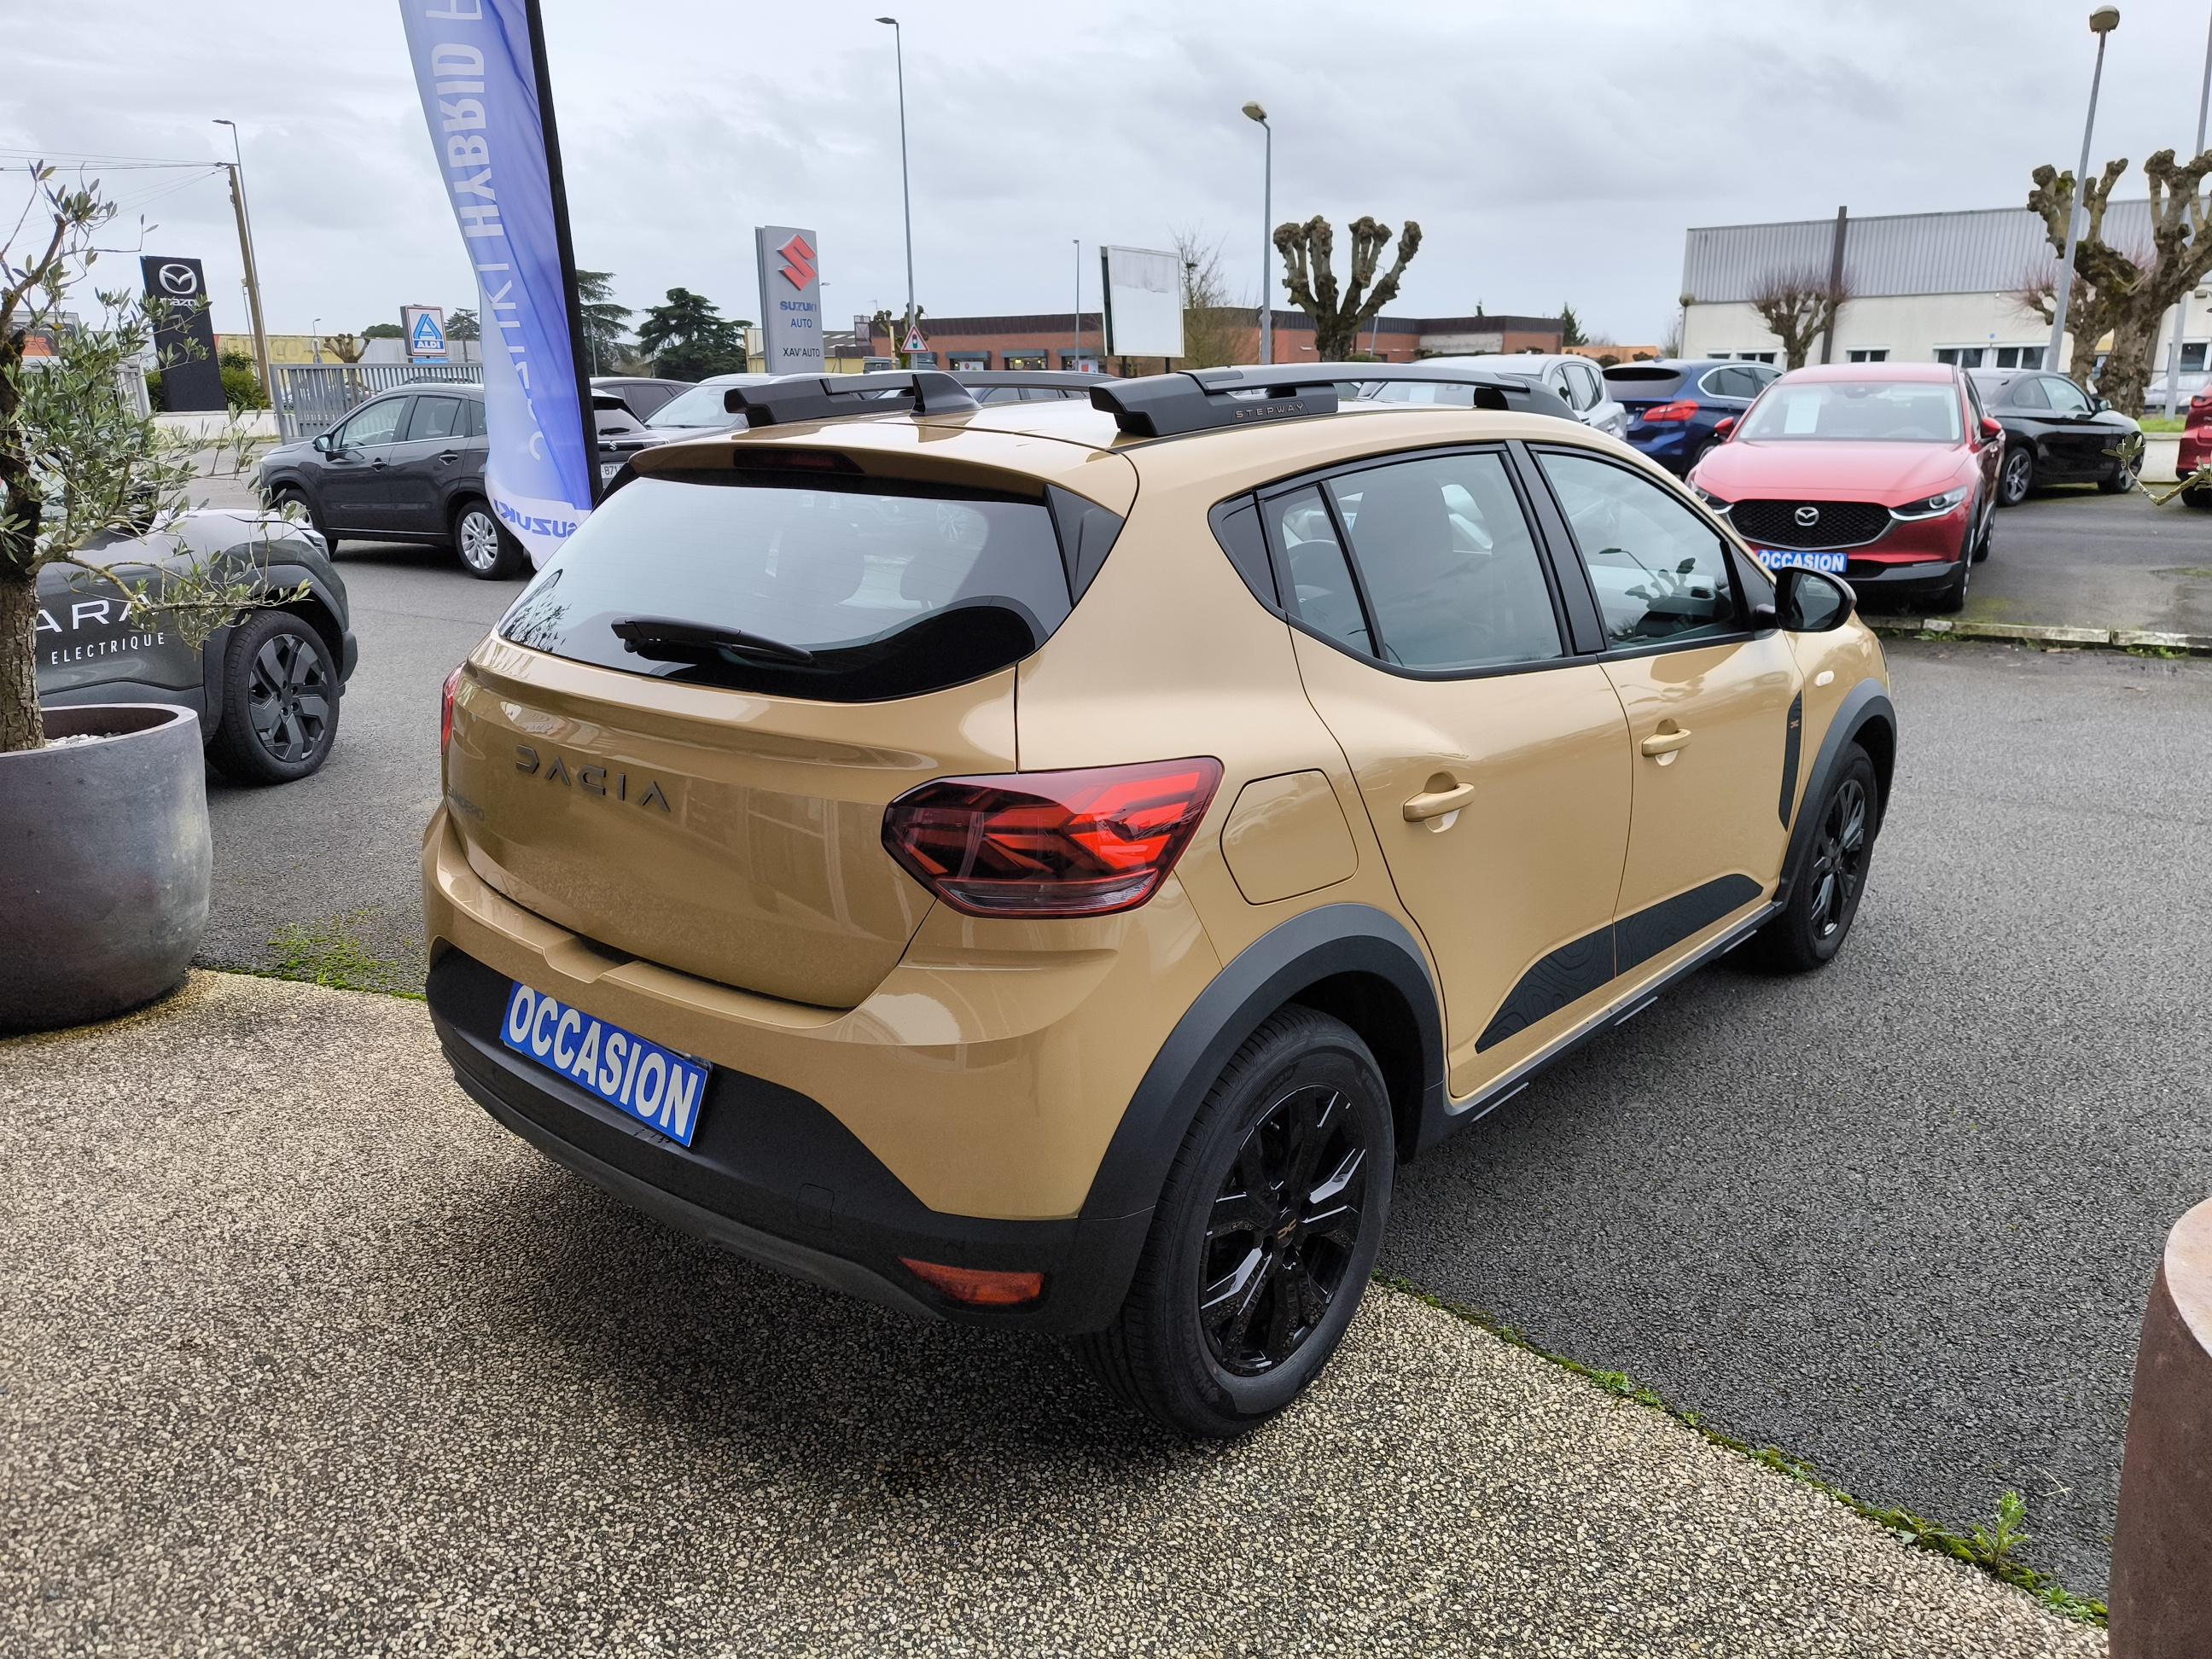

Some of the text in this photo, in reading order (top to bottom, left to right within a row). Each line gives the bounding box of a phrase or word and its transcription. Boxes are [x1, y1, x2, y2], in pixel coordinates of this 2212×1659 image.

[780, 300, 817, 312] SUZUKI
[790, 317, 812, 329] AUTO
[416, 341, 441, 349] ALDI
[783, 347, 820, 358] XAV'AUTO
[1235, 402, 1304, 418] STEPWAY
[1758, 550, 1846, 572] OCCASION
[51, 632, 165, 665] ELECTRIQUE
[515, 744, 672, 812] DACIA
[508, 984, 700, 1138] OCCASION
